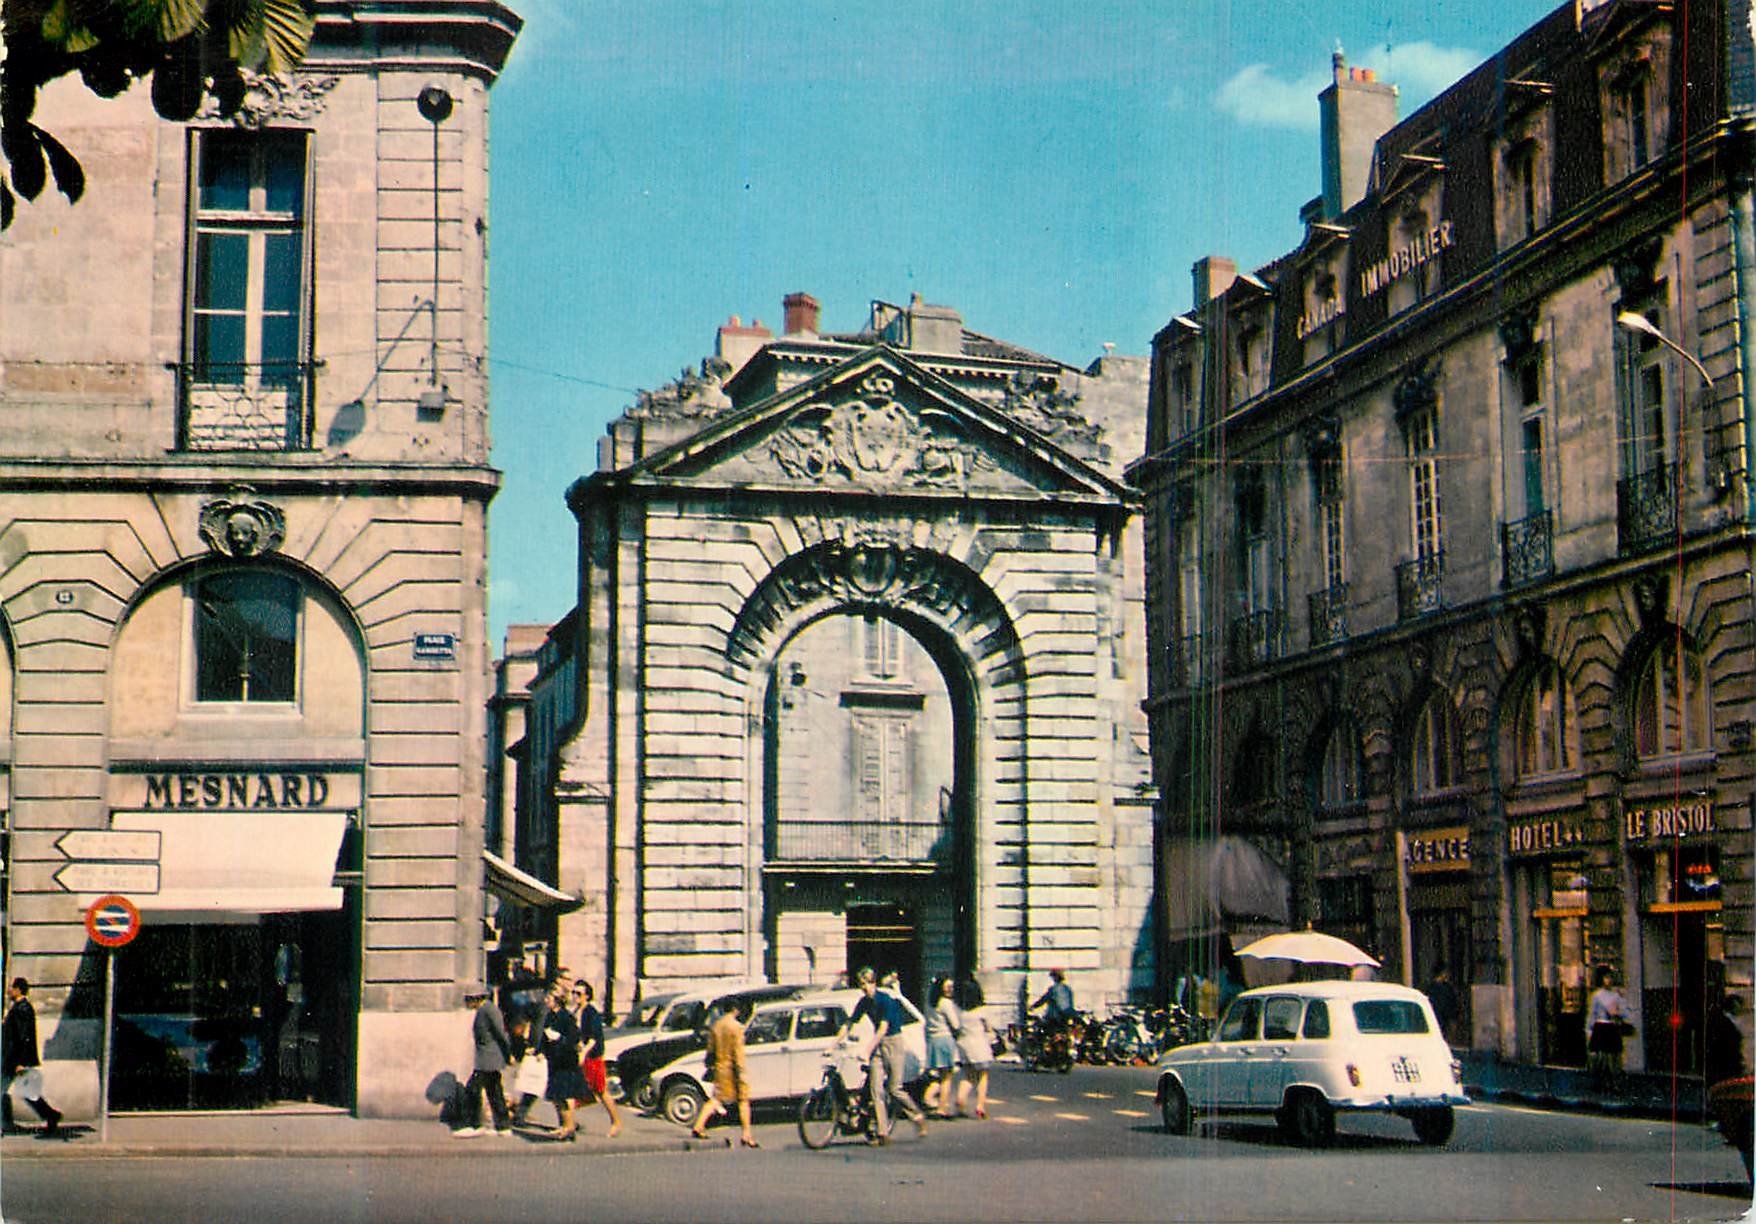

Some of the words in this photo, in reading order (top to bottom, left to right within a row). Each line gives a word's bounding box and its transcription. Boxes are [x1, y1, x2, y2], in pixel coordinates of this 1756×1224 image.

[1361, 220, 1454, 298] IMMOBILIER
[144, 774, 328, 809] MESNARD
[1511, 820, 1562, 851] HOTEL
[1626, 811, 1646, 840] LE
[1652, 803, 1714, 837] BRISTOL
